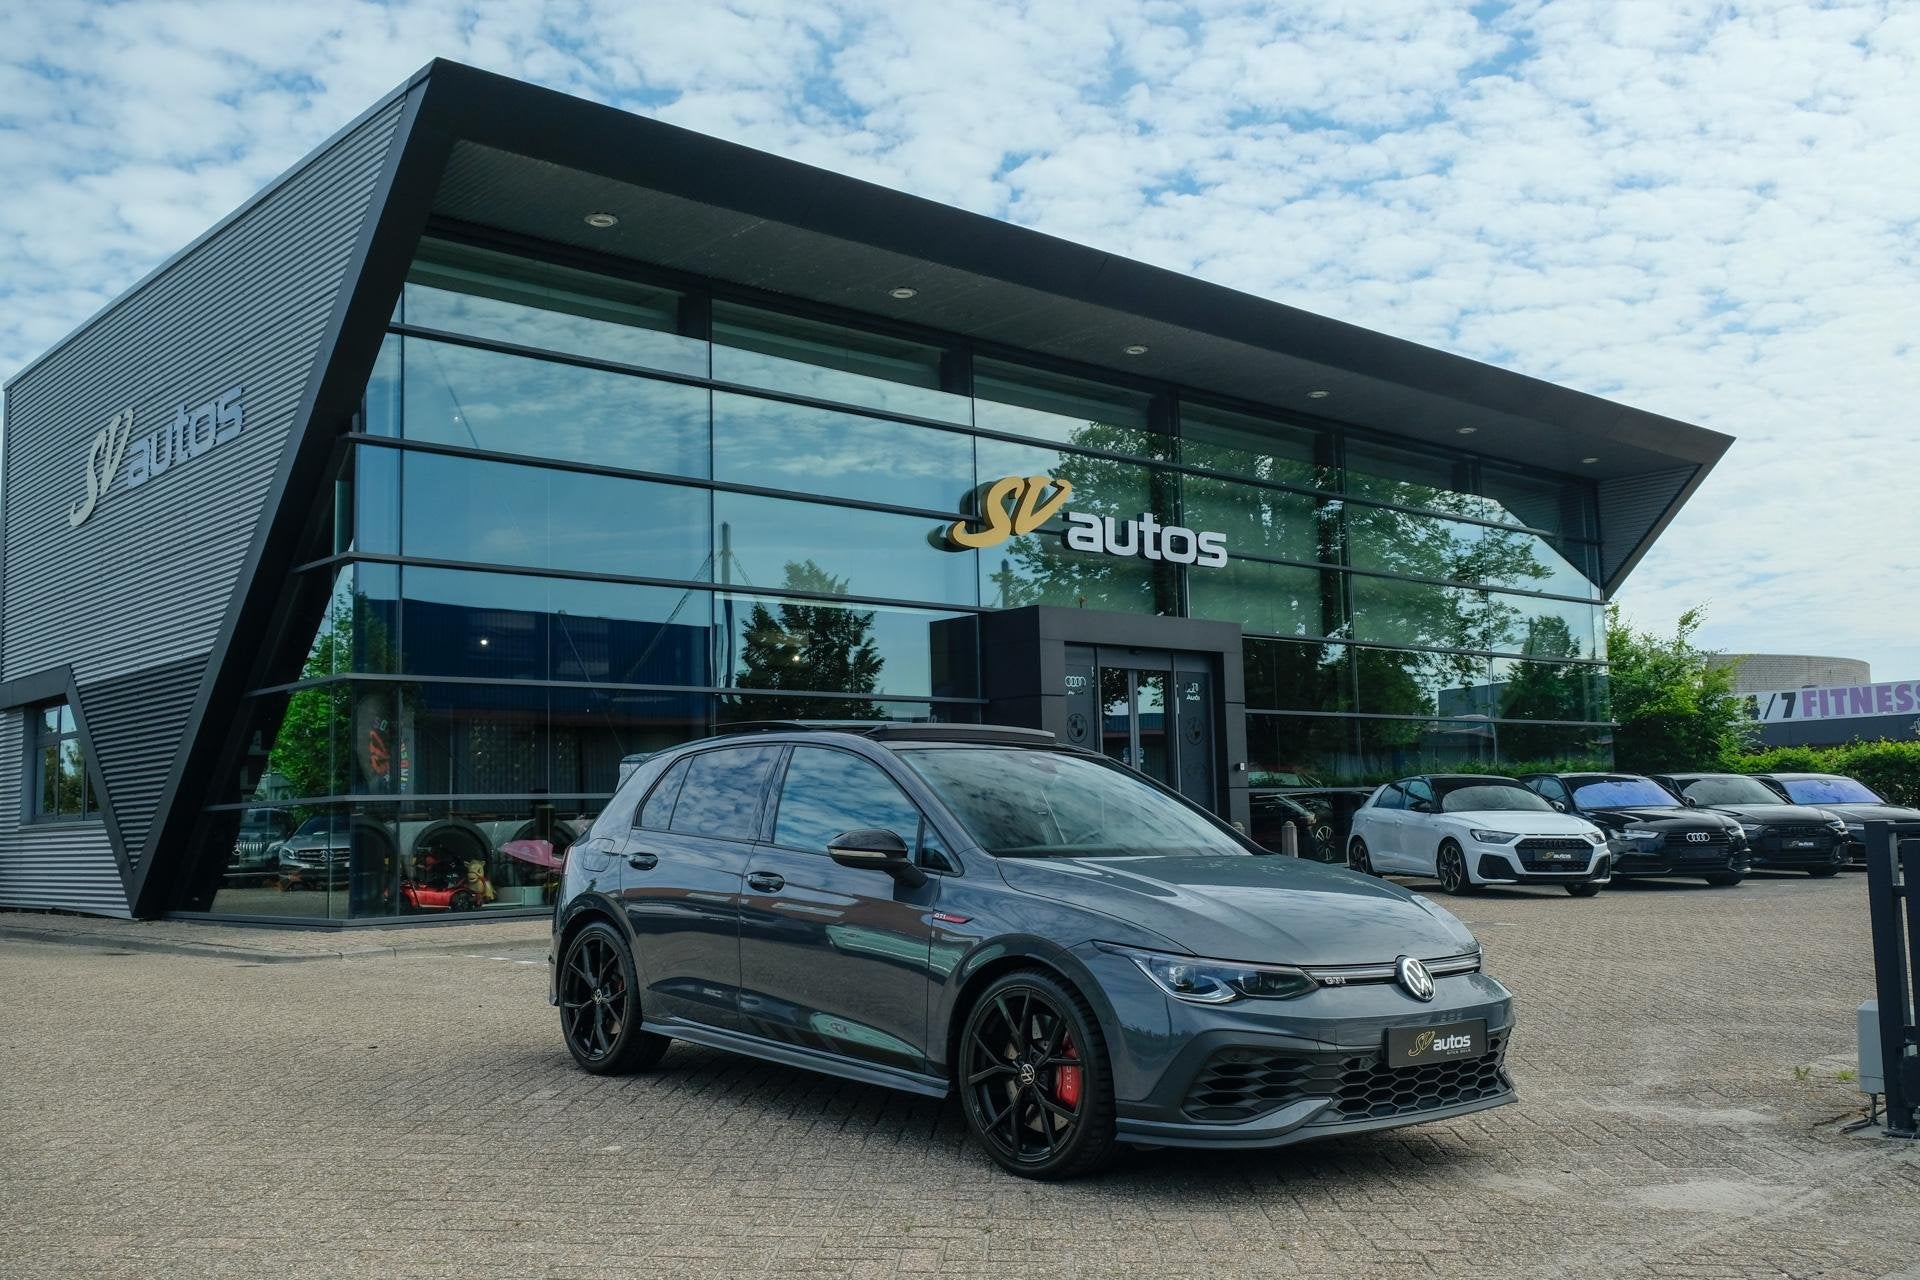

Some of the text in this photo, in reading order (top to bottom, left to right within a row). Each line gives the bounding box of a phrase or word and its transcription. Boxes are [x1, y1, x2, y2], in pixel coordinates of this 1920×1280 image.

[128, 385, 243, 489] autos
[952, 476, 1228, 568] SV autos
[1802, 684, 1920, 717] FITNES
[1324, 976, 1346, 985] GTI
[1433, 1034, 1471, 1051] autos
